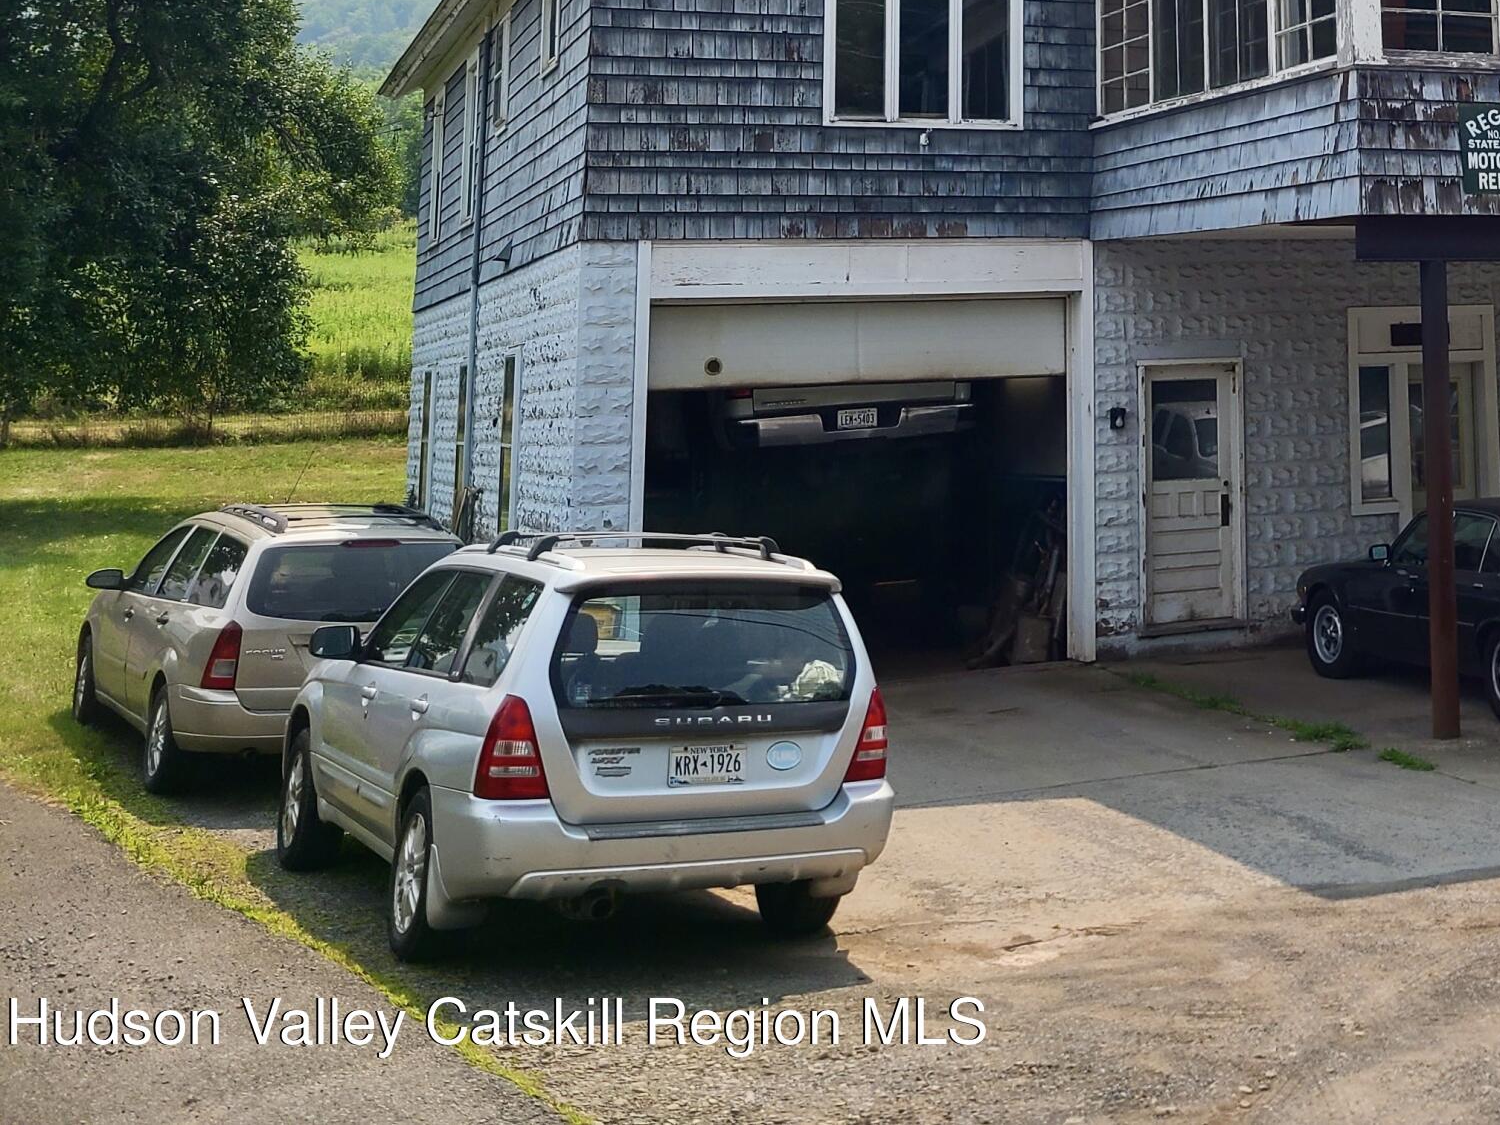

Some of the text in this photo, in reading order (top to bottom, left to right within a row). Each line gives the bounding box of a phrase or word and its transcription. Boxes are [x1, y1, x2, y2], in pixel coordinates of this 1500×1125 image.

[1487, 130, 1500, 139] NO.
[1468, 139, 1500, 149] STATE
[675, 753, 741, 776] KRX 1926
